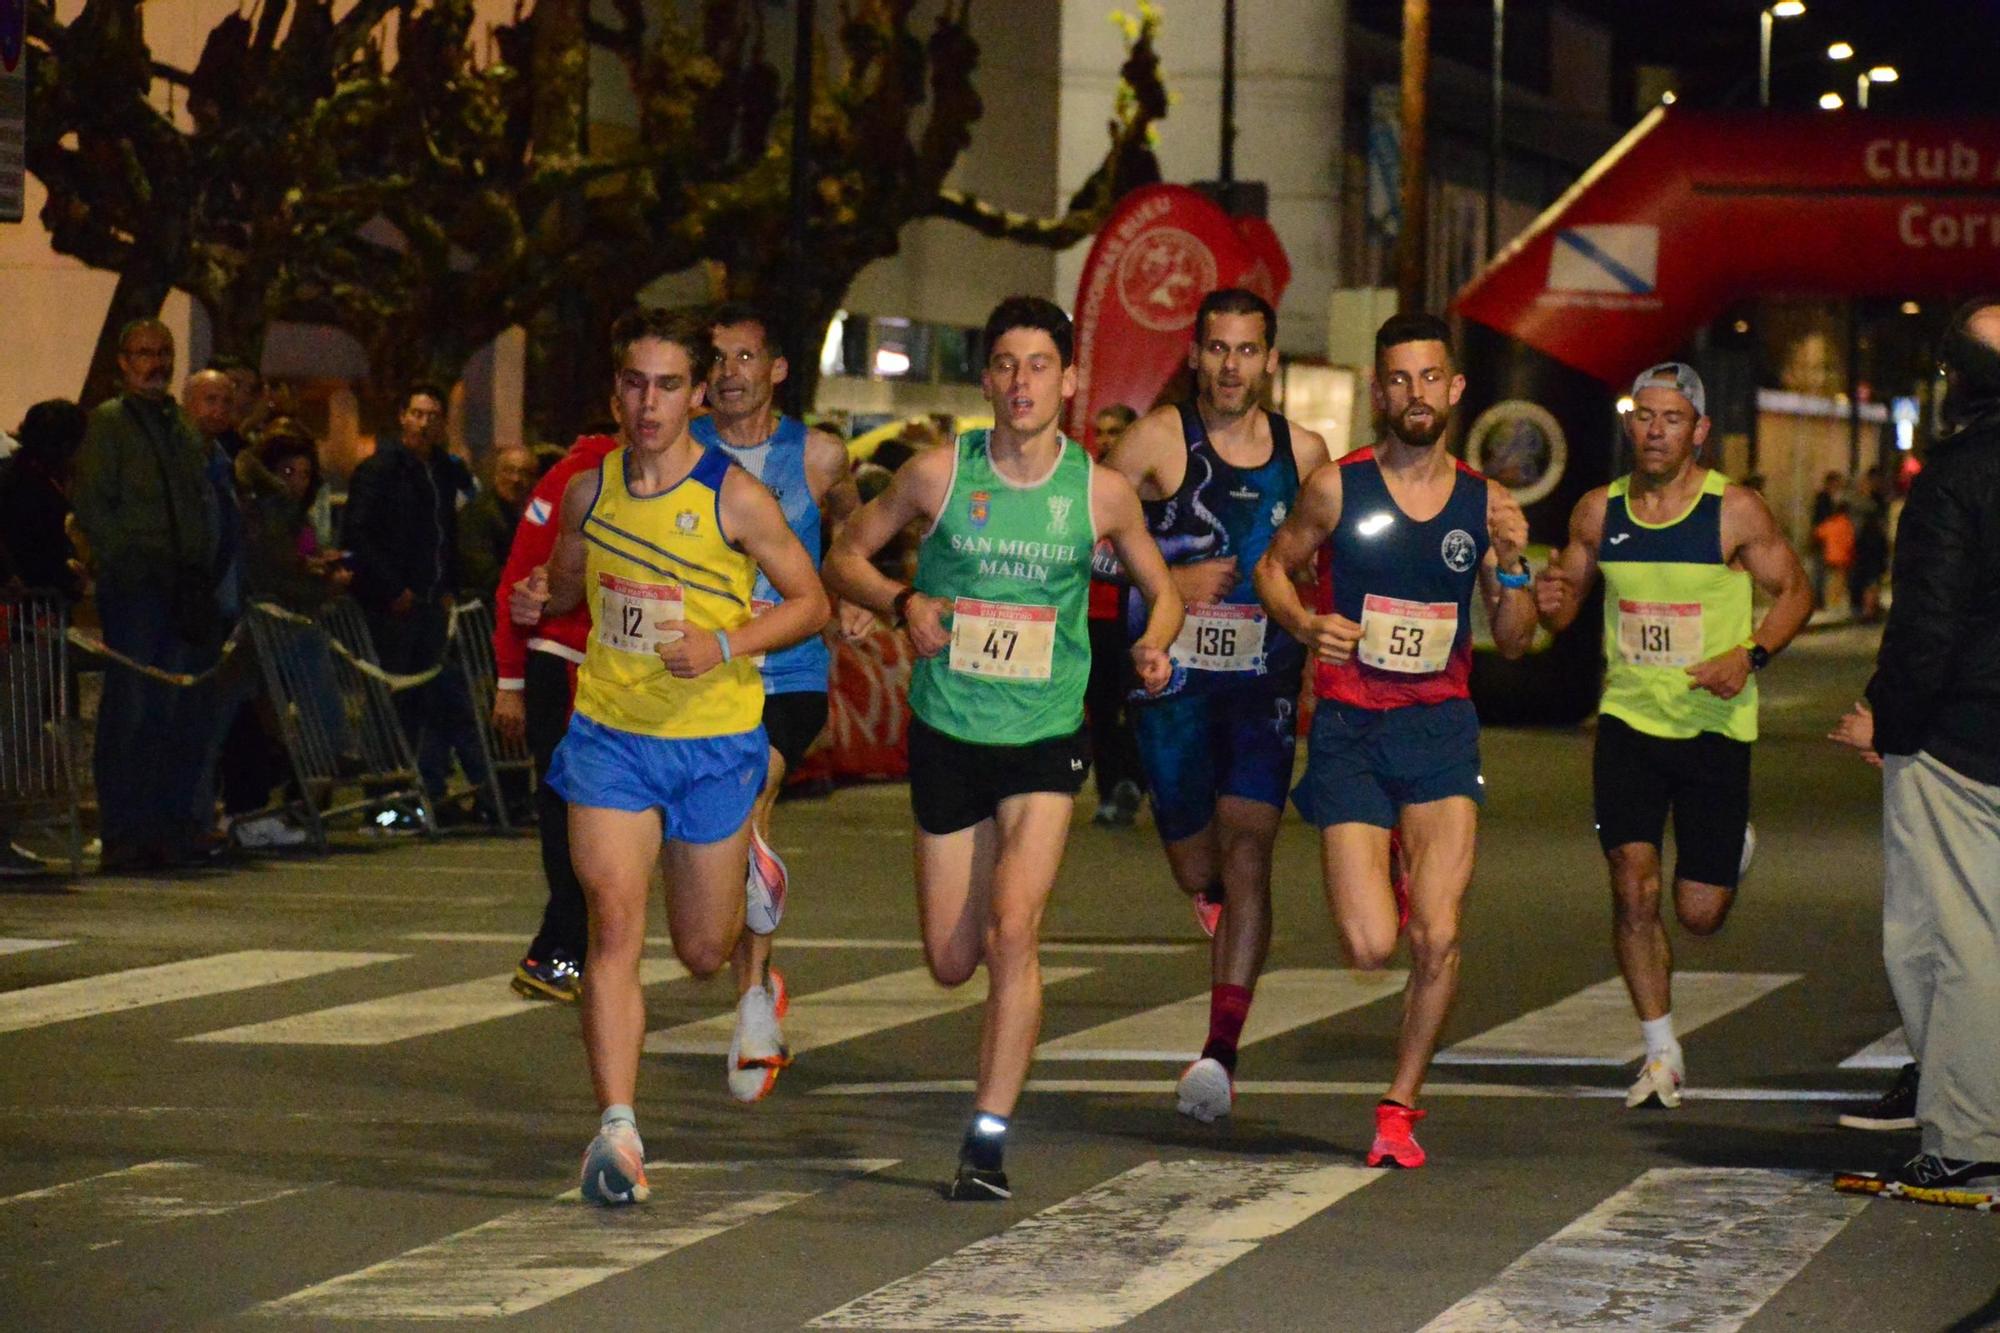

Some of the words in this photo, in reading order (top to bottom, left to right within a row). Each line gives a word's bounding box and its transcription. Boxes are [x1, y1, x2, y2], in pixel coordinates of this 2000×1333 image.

[1864, 139, 1980, 182] Club
[951, 534, 992, 554] SAN
[998, 539, 1079, 561] MIGUEL
[623, 605, 642, 638] 12
[983, 629, 1018, 661] 47
[1196, 627, 1236, 657] 136
[1389, 626, 1424, 657] 53
[1641, 624, 1670, 652] 131
